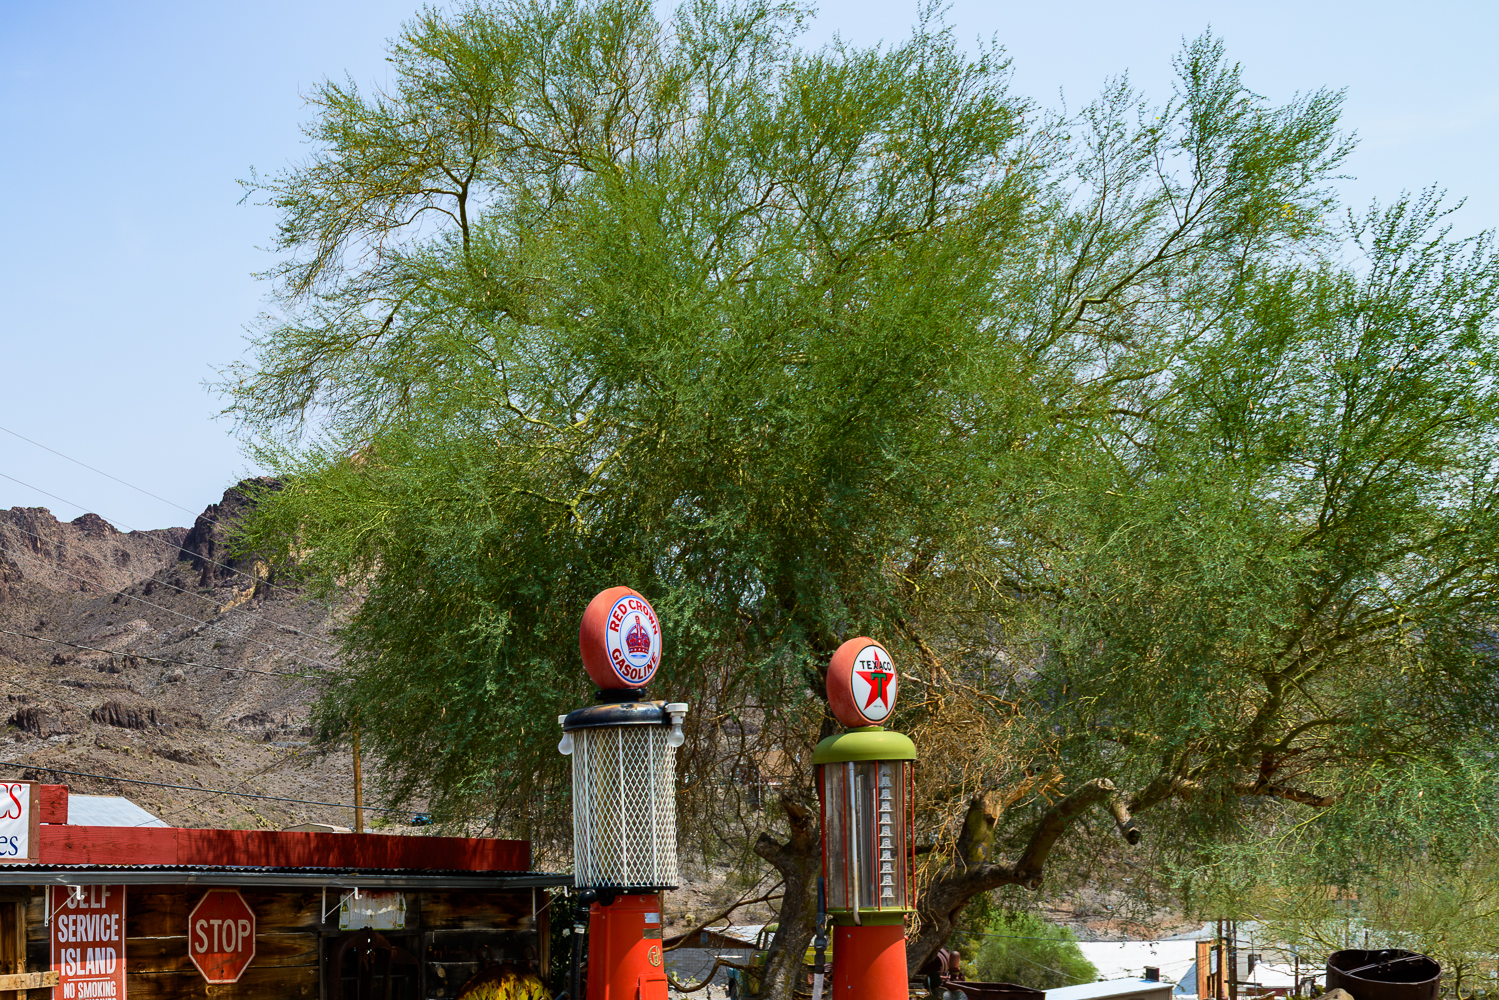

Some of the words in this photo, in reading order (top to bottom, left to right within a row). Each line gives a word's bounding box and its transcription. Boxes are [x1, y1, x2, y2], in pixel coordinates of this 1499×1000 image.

[609, 603, 628, 633] RED
[628, 599, 658, 636] CROWN
[611, 648, 658, 680] GASOLINE
[859, 660, 892, 671] TEXACO
[66, 885, 111, 909] SELF
[57, 913, 120, 943] SERVICE
[194, 918, 251, 954] STOP
[60, 947, 117, 976] ISLAND
[64, 982, 75, 999] NO
[78, 980, 117, 998] SMOKING
